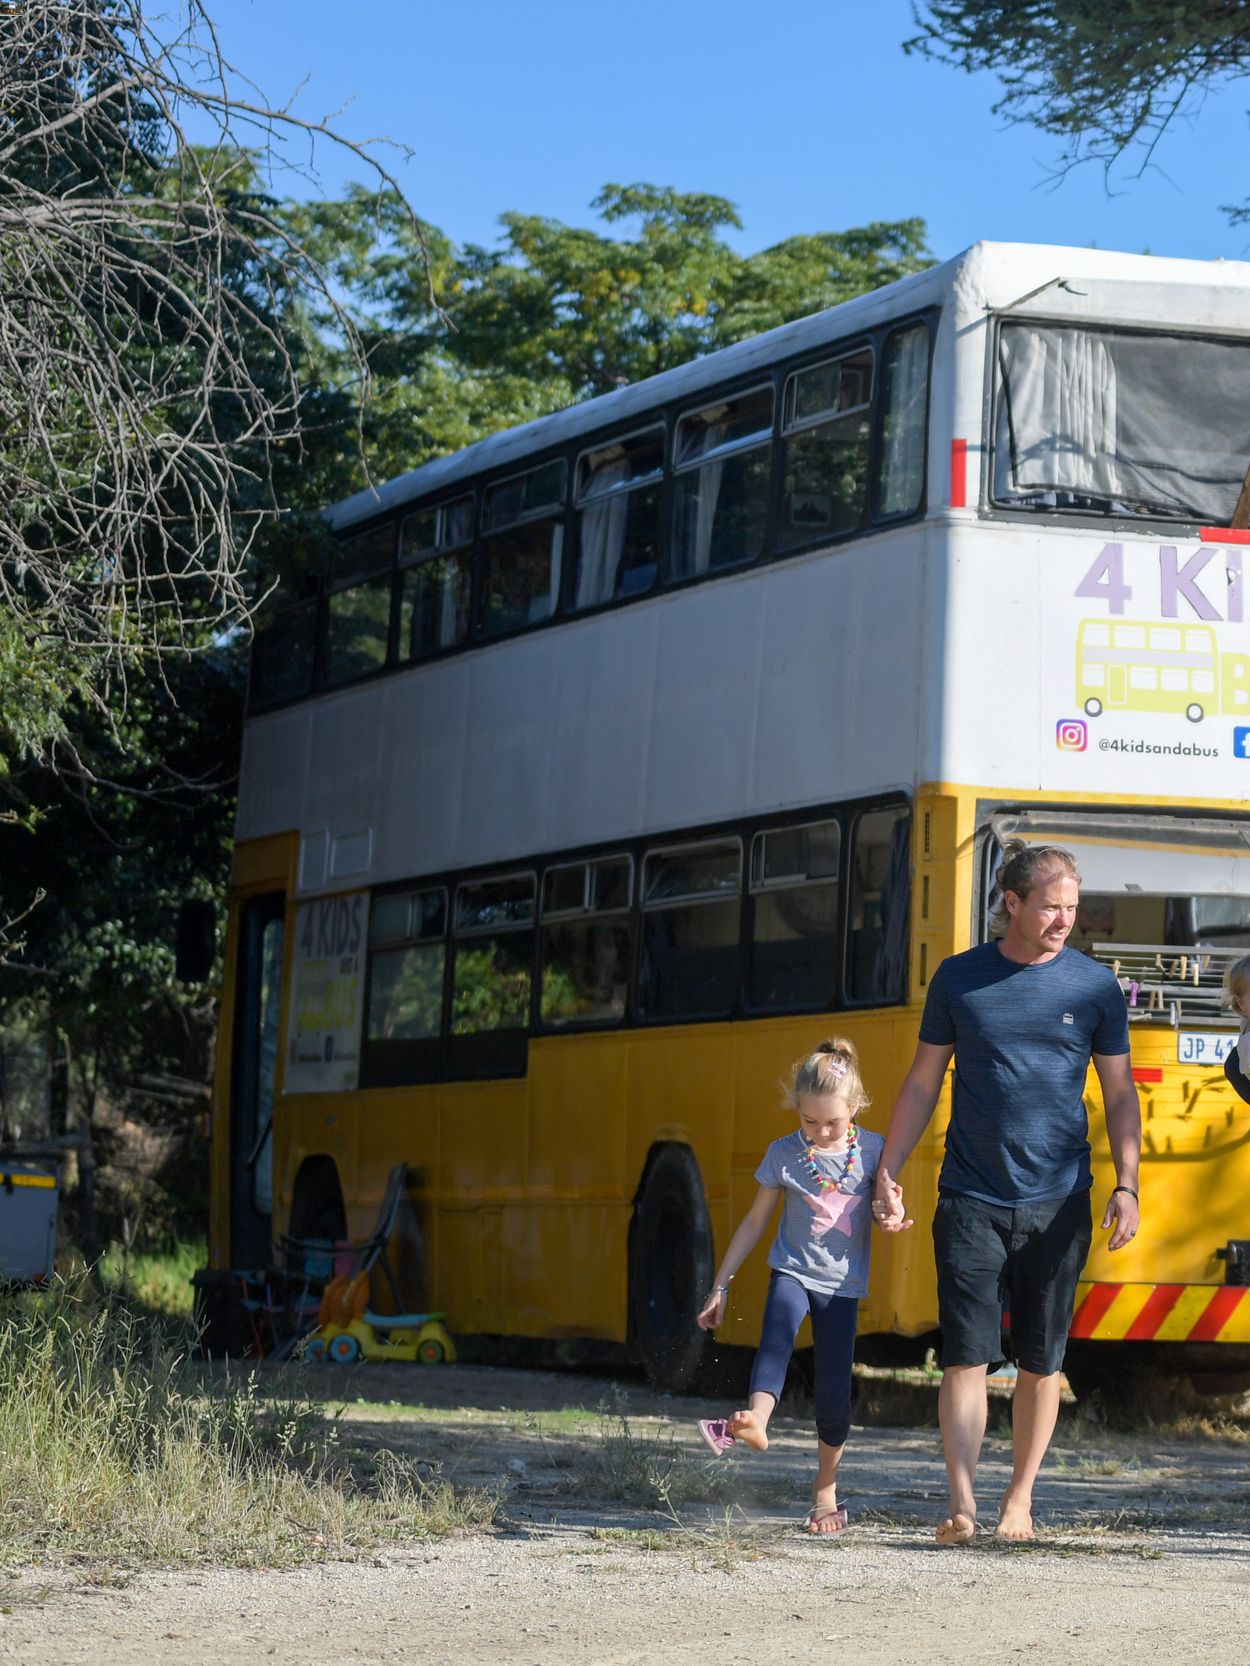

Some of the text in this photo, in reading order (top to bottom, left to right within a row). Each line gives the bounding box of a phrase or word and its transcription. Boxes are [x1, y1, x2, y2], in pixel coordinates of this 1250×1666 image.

[1074, 543, 1133, 615] 4
[1098, 738, 1219, 758] @4kidsandabus
[301, 895, 363, 957] 4 KIDS
[1183, 1037, 1205, 1059] JP
